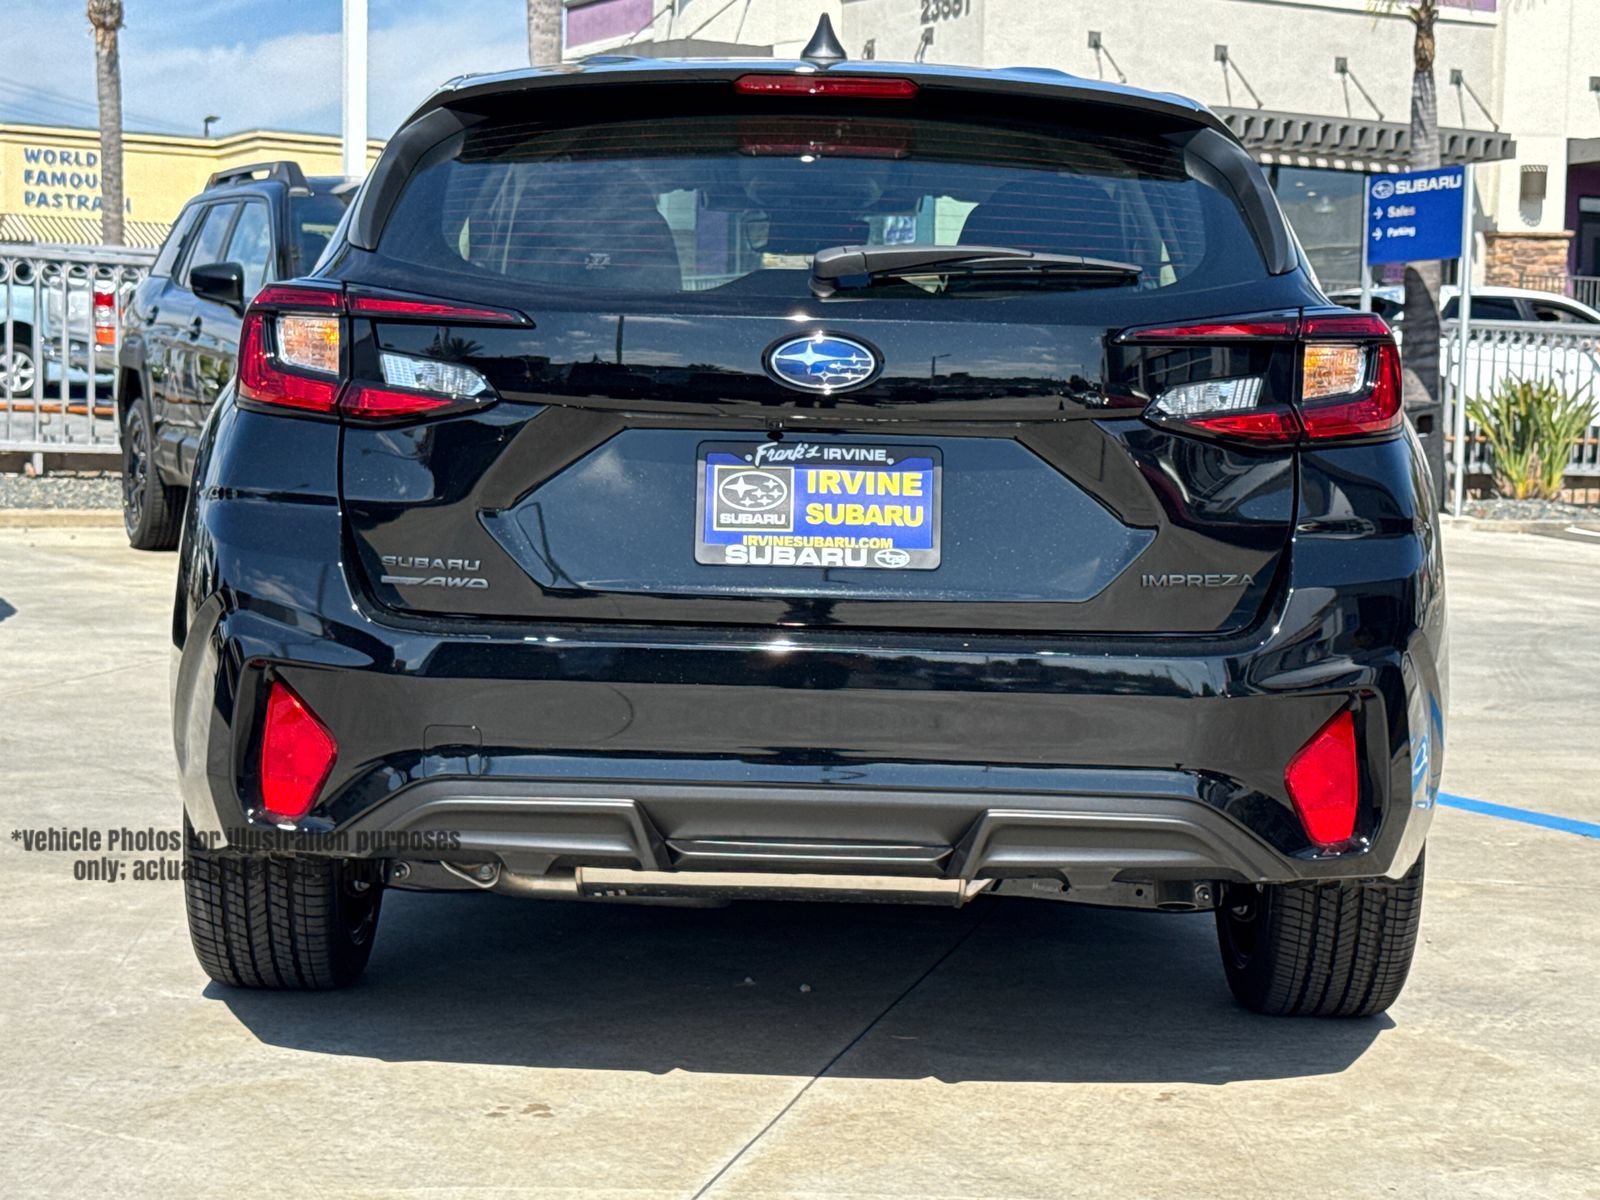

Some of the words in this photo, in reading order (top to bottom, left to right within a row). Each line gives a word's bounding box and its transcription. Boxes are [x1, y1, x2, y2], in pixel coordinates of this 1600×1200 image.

[24, 148, 98, 167] WORLD
[24, 169, 102, 189] FAMOU
[1395, 174, 1462, 195] SUBARU
[24, 191, 132, 214] PASTRAI
[824, 448, 886, 461] IRVINE
[807, 470, 923, 496] IRVINE
[719, 513, 786, 525] SUBARU
[805, 503, 924, 527] SUBARU
[743, 535, 893, 549] IRVINESUBARU.COM
[381, 555, 480, 571] SUBARU
[725, 544, 868, 567] SUBARU
[1142, 573, 1256, 588] IMPREZA
